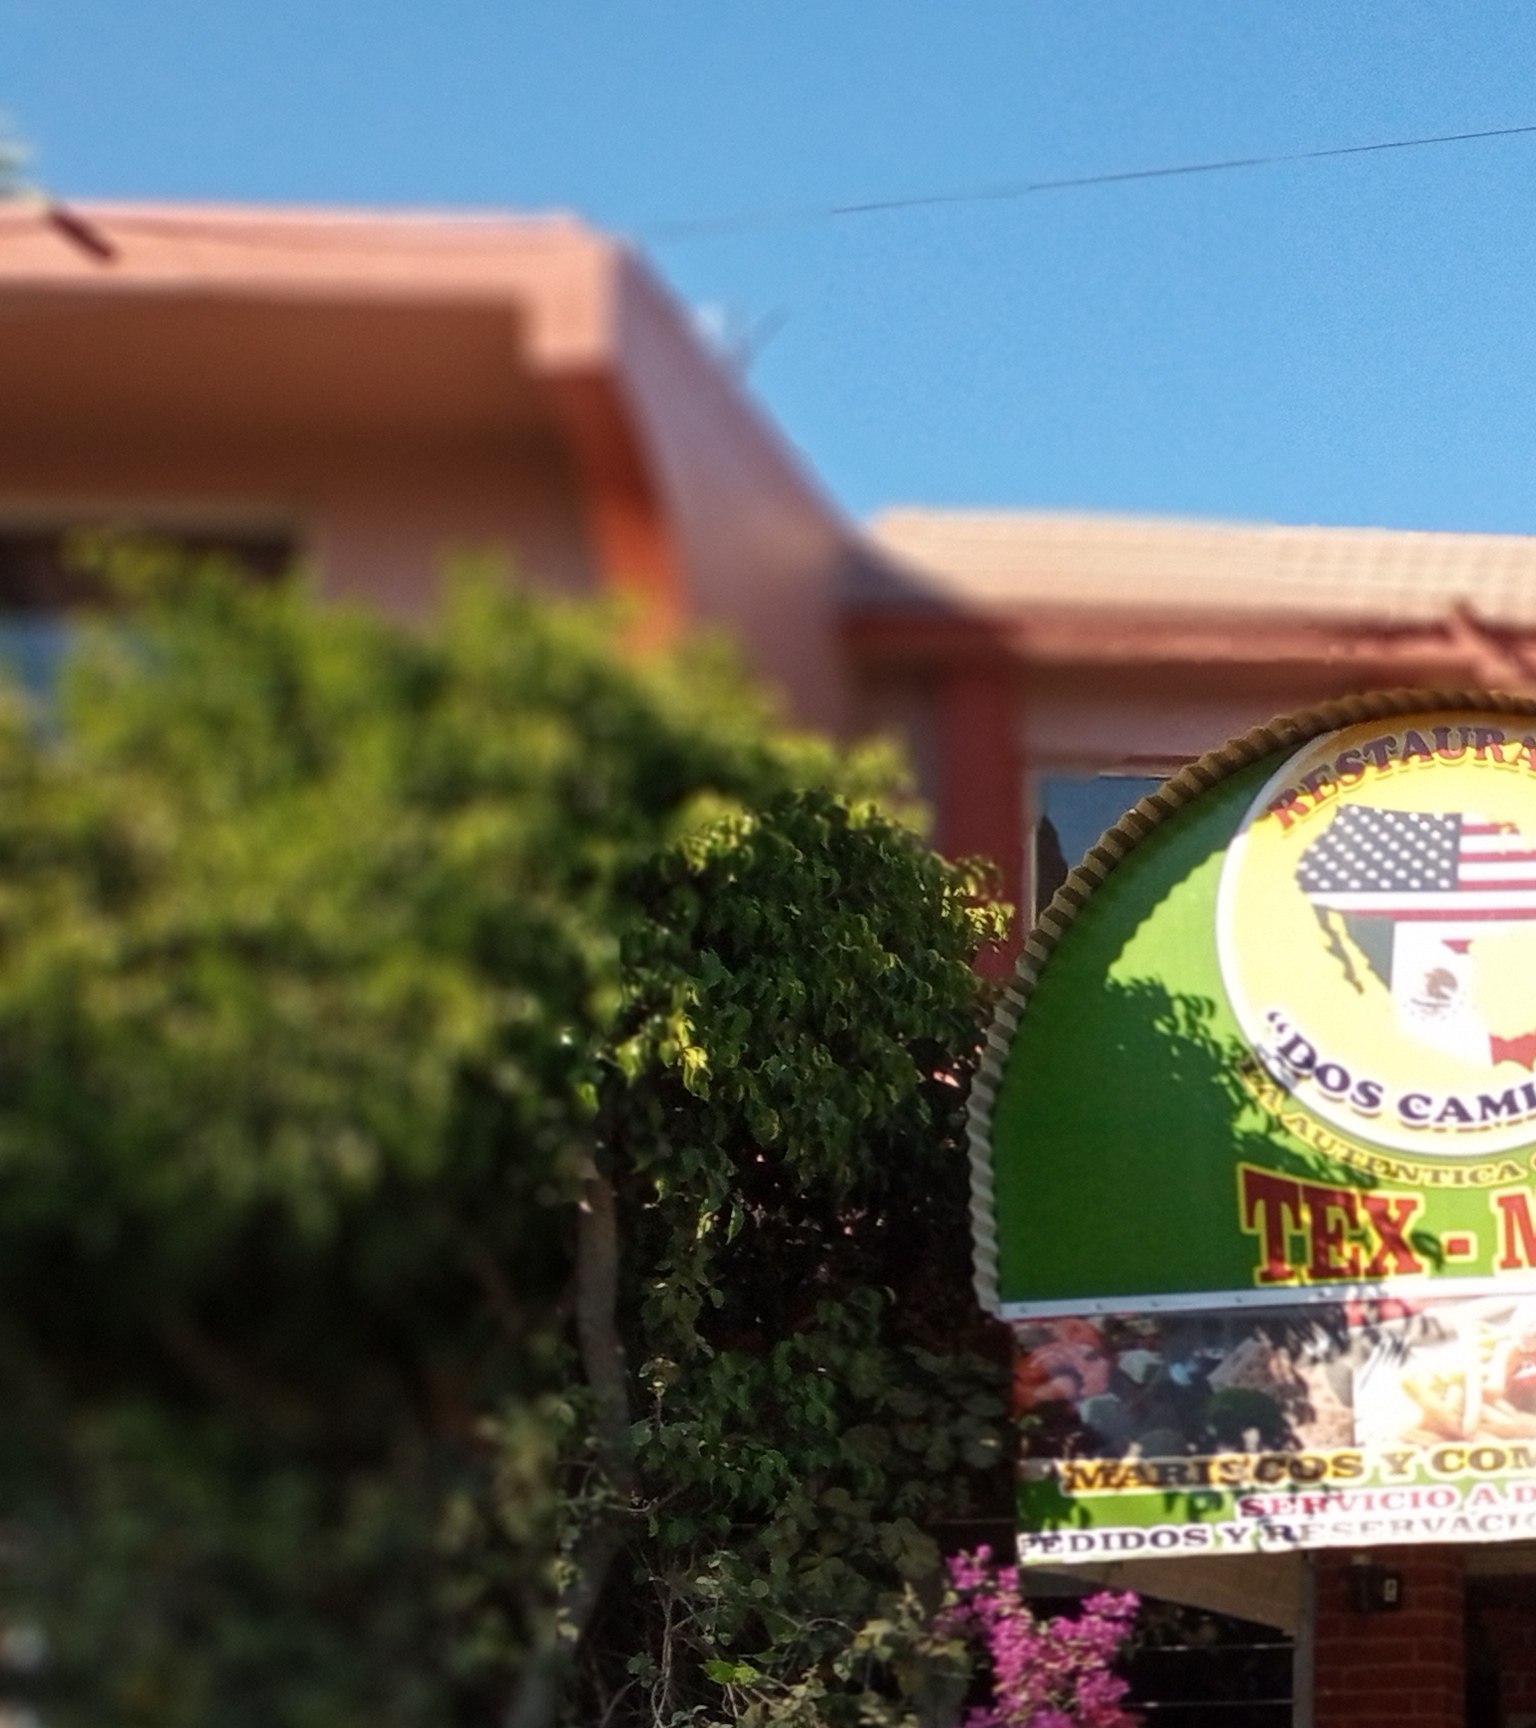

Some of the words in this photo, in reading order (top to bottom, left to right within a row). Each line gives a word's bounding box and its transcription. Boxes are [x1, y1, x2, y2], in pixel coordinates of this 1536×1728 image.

[1287, 1112, 1523, 1185] AUTENTICA
[1240, 1165, 1424, 1284] TEX
[1064, 1452, 1364, 1491] MARISCOS
[1382, 1451, 1416, 1475] Y
[1239, 1487, 1456, 1518] SERVICIO
[1472, 1486, 1498, 1506] A
[1020, 1527, 1208, 1556] PEDIDOS
[1224, 1526, 1249, 1544] Y
